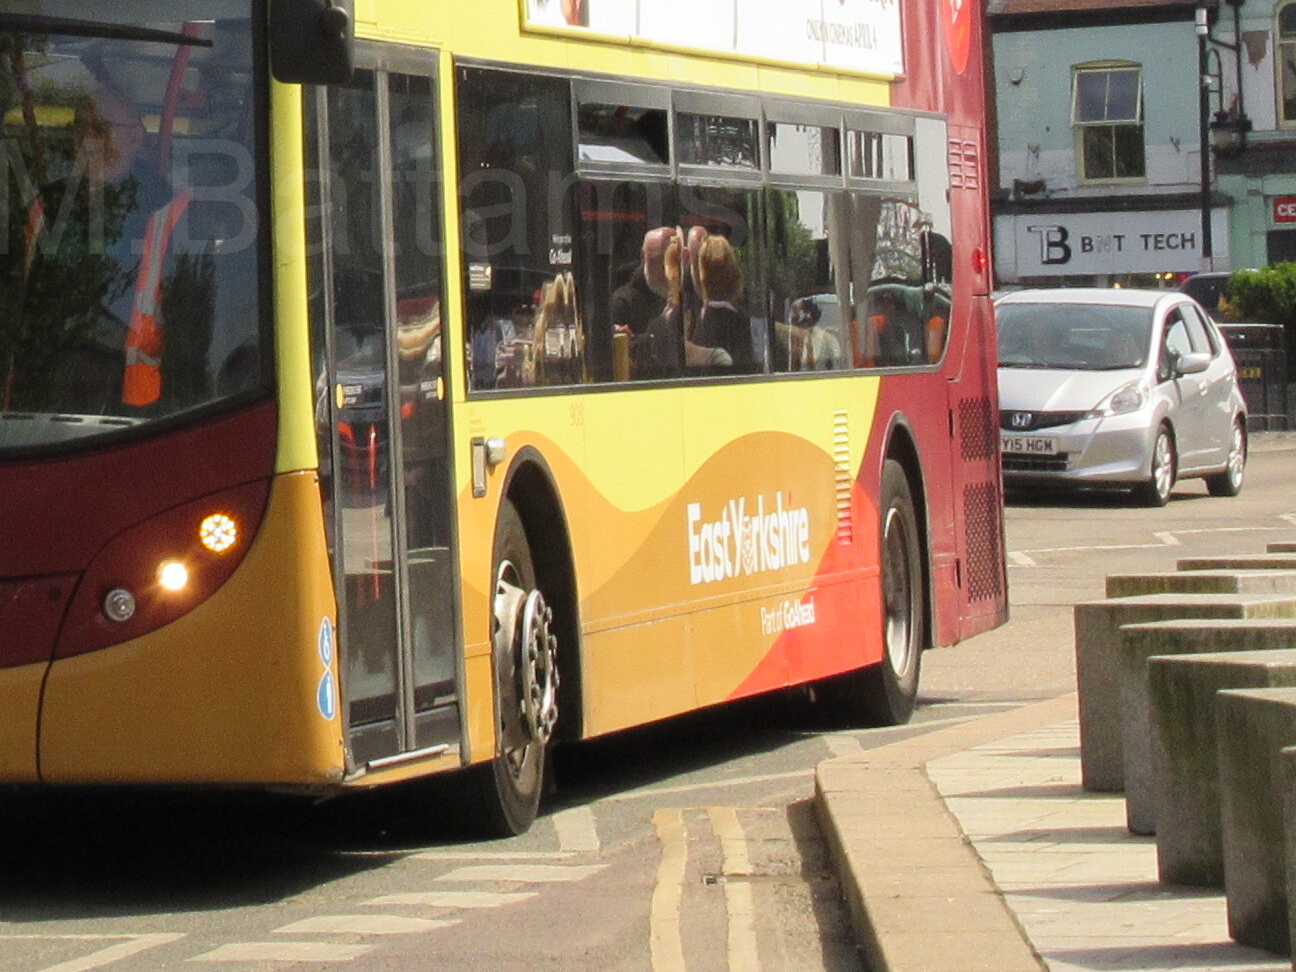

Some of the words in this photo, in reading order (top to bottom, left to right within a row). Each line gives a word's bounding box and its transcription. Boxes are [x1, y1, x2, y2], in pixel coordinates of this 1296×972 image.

[1140, 232, 1196, 251] TECH
[1001, 438, 1023, 451] Y15
[686, 502, 733, 586] East
[760, 605, 776, 635] Part
[775, 601, 784, 633] of
